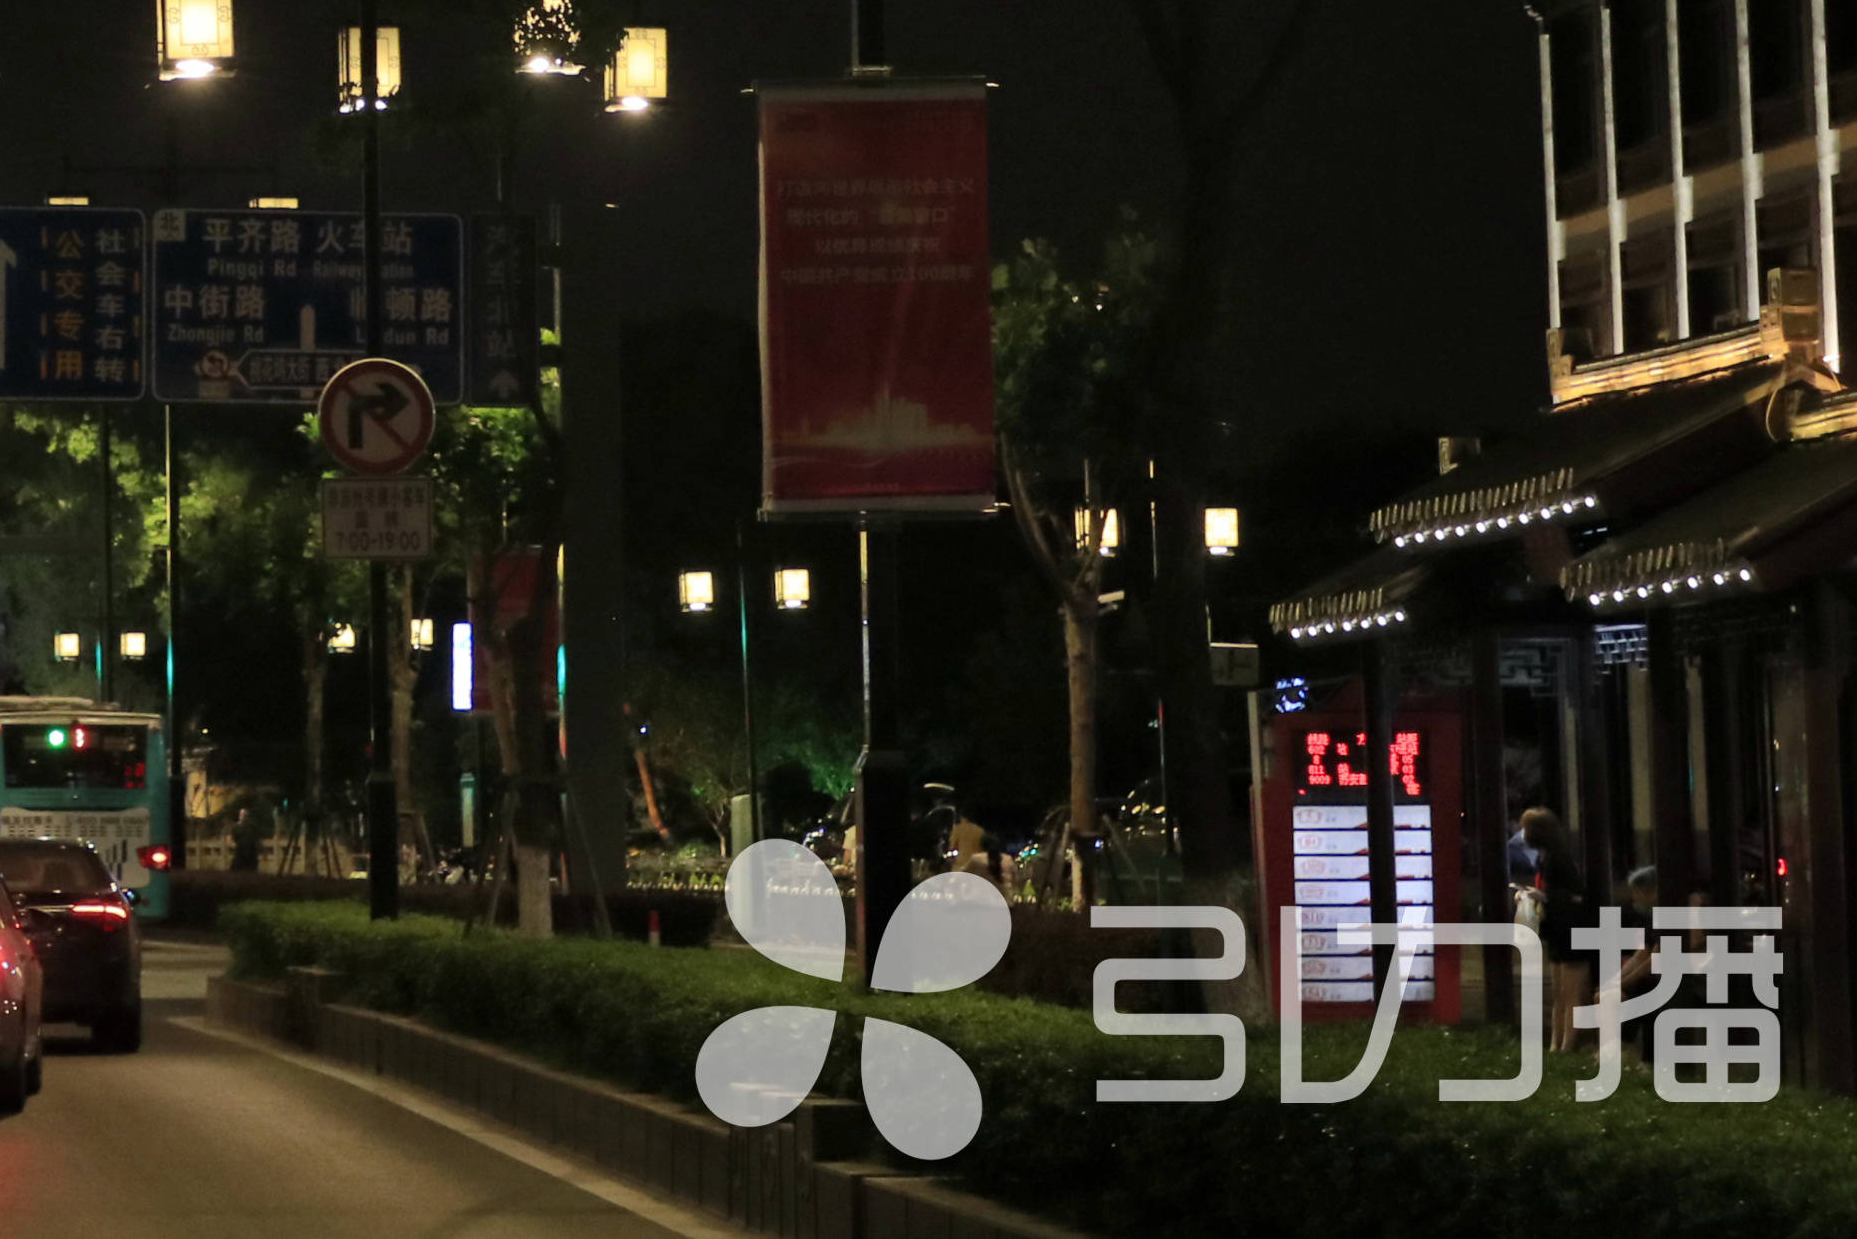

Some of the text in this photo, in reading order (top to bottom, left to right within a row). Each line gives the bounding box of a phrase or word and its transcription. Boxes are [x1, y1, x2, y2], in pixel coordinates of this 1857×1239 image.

[159, 212, 180, 232] 北
[203, 218, 301, 254] 平齐路
[207, 258, 264, 279] Pingqi
[274, 259, 297, 276] Rd
[54, 228, 86, 381] 公交专用
[94, 227, 127, 383] 社会车右转
[165, 284, 266, 320] 中街路
[168, 324, 235, 344] Zhongjie
[243, 324, 264, 342] Rd
[426, 326, 449, 345] Rd
